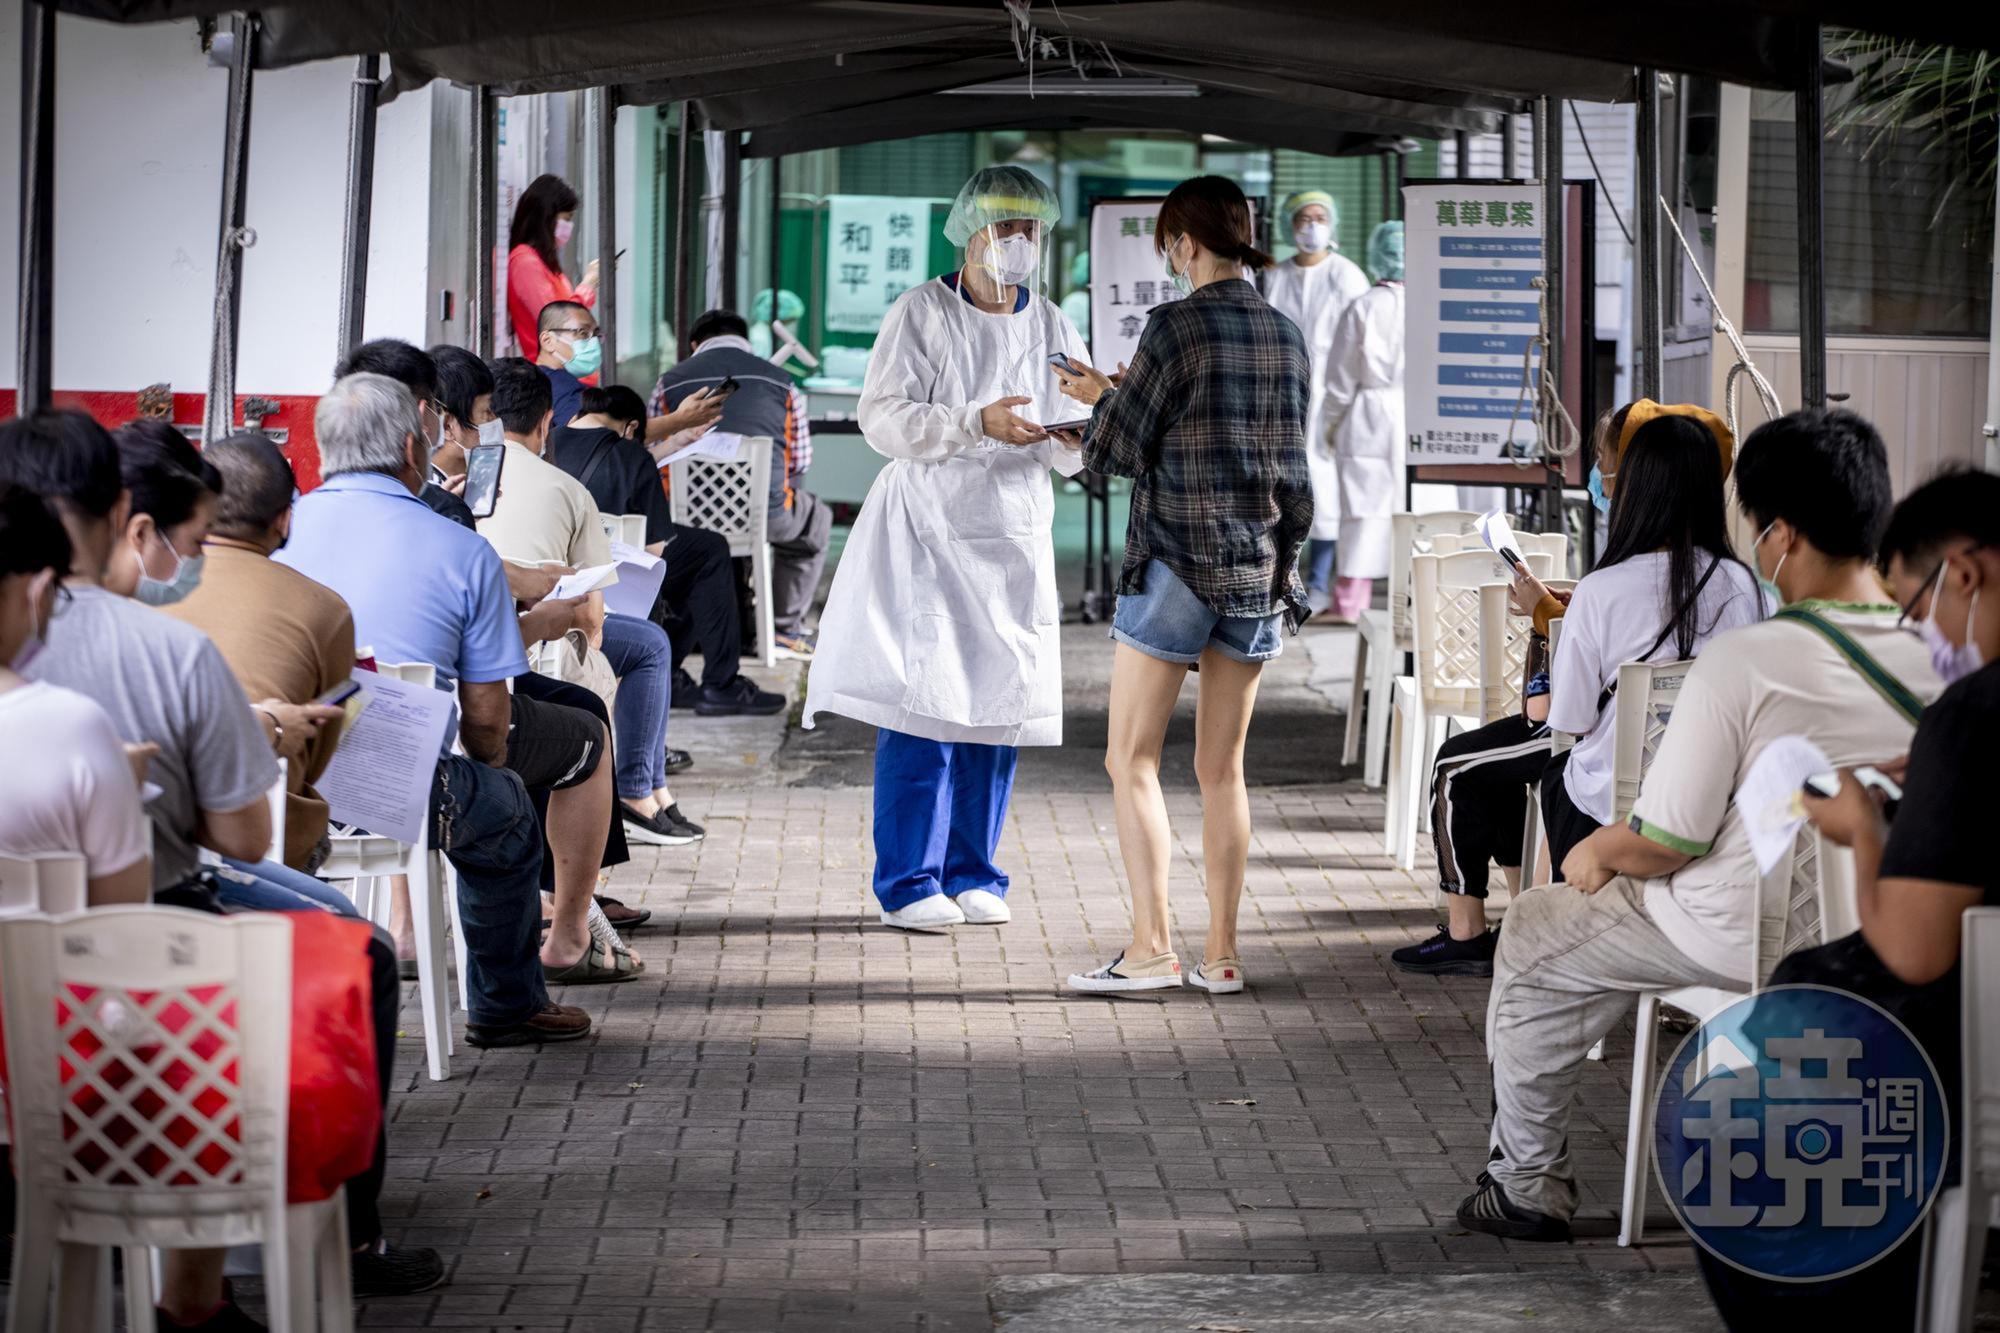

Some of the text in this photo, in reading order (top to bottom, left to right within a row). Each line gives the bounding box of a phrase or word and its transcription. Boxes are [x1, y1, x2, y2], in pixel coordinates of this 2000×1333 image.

[1436, 200, 1534, 227] 萬華專案
[840, 222, 871, 294] 和平
